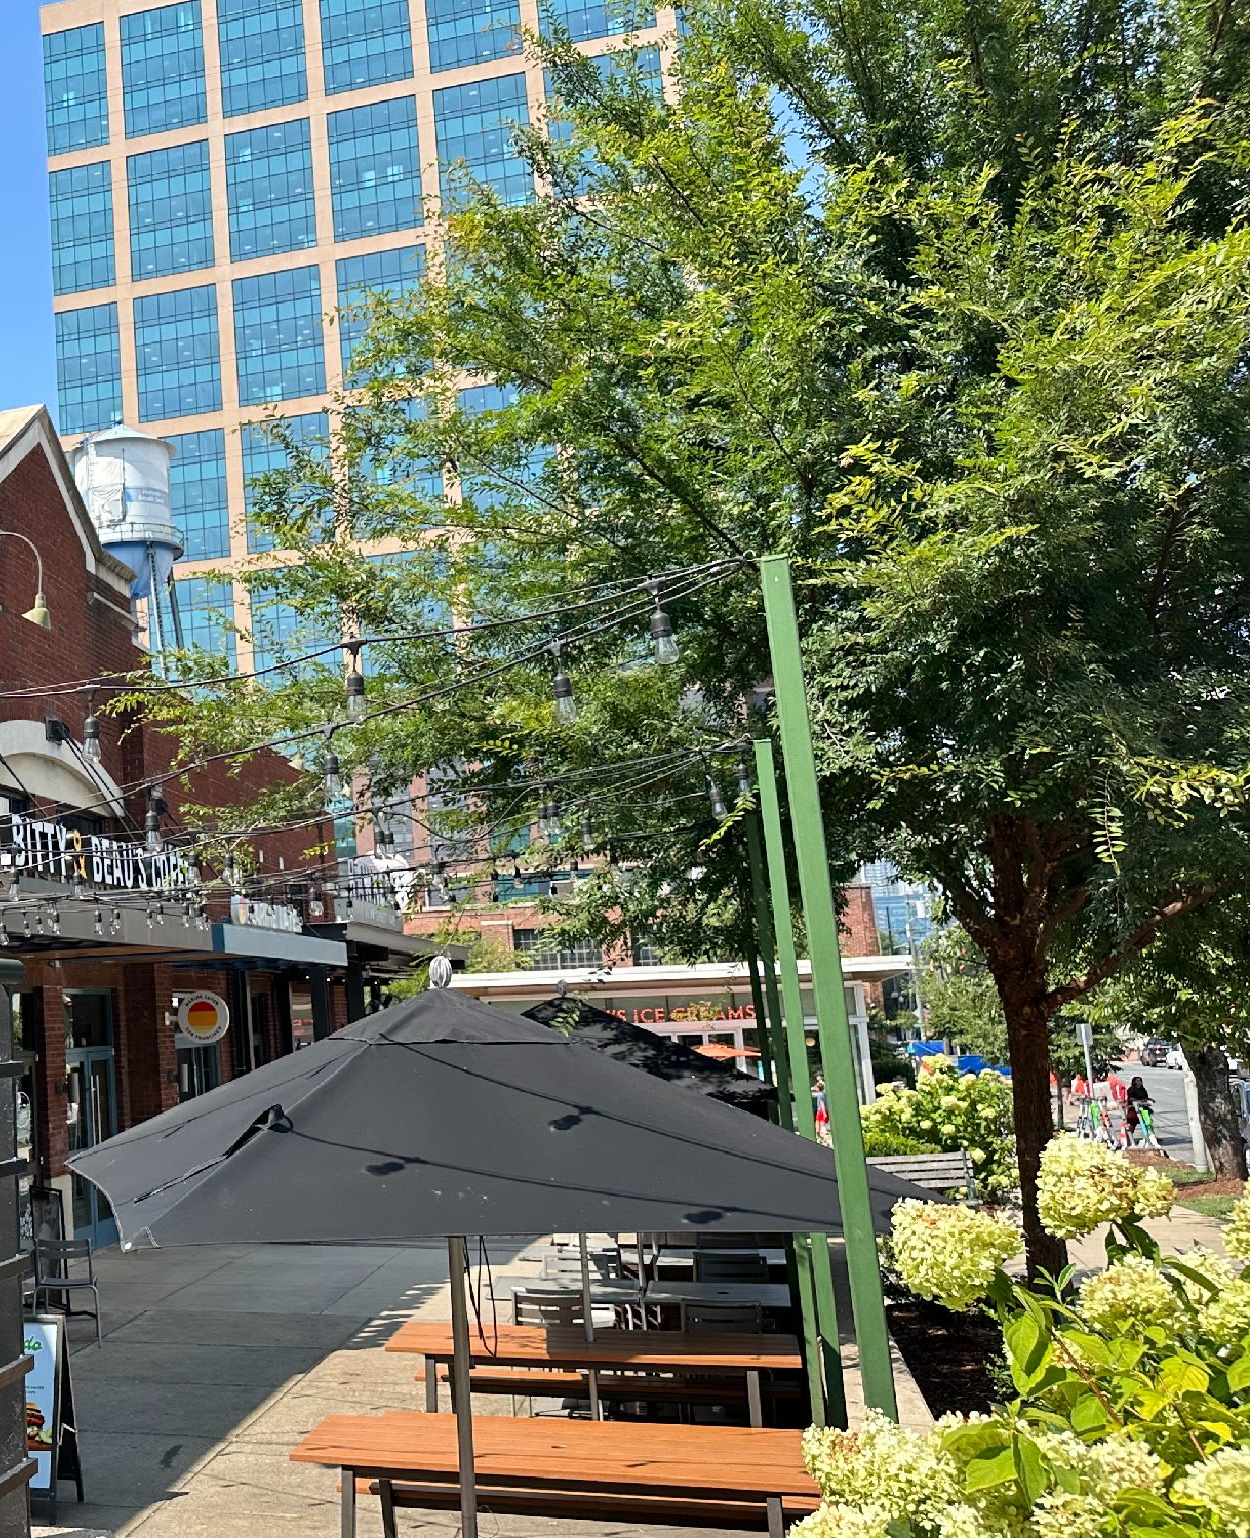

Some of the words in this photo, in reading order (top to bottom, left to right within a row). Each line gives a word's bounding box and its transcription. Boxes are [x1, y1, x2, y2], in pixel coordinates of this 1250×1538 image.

[11, 813, 67, 882] BITTY
[73, 830, 88, 880] &
[91, 835, 148, 889] BEAU'S
[633, 1008, 665, 1023] ICE
